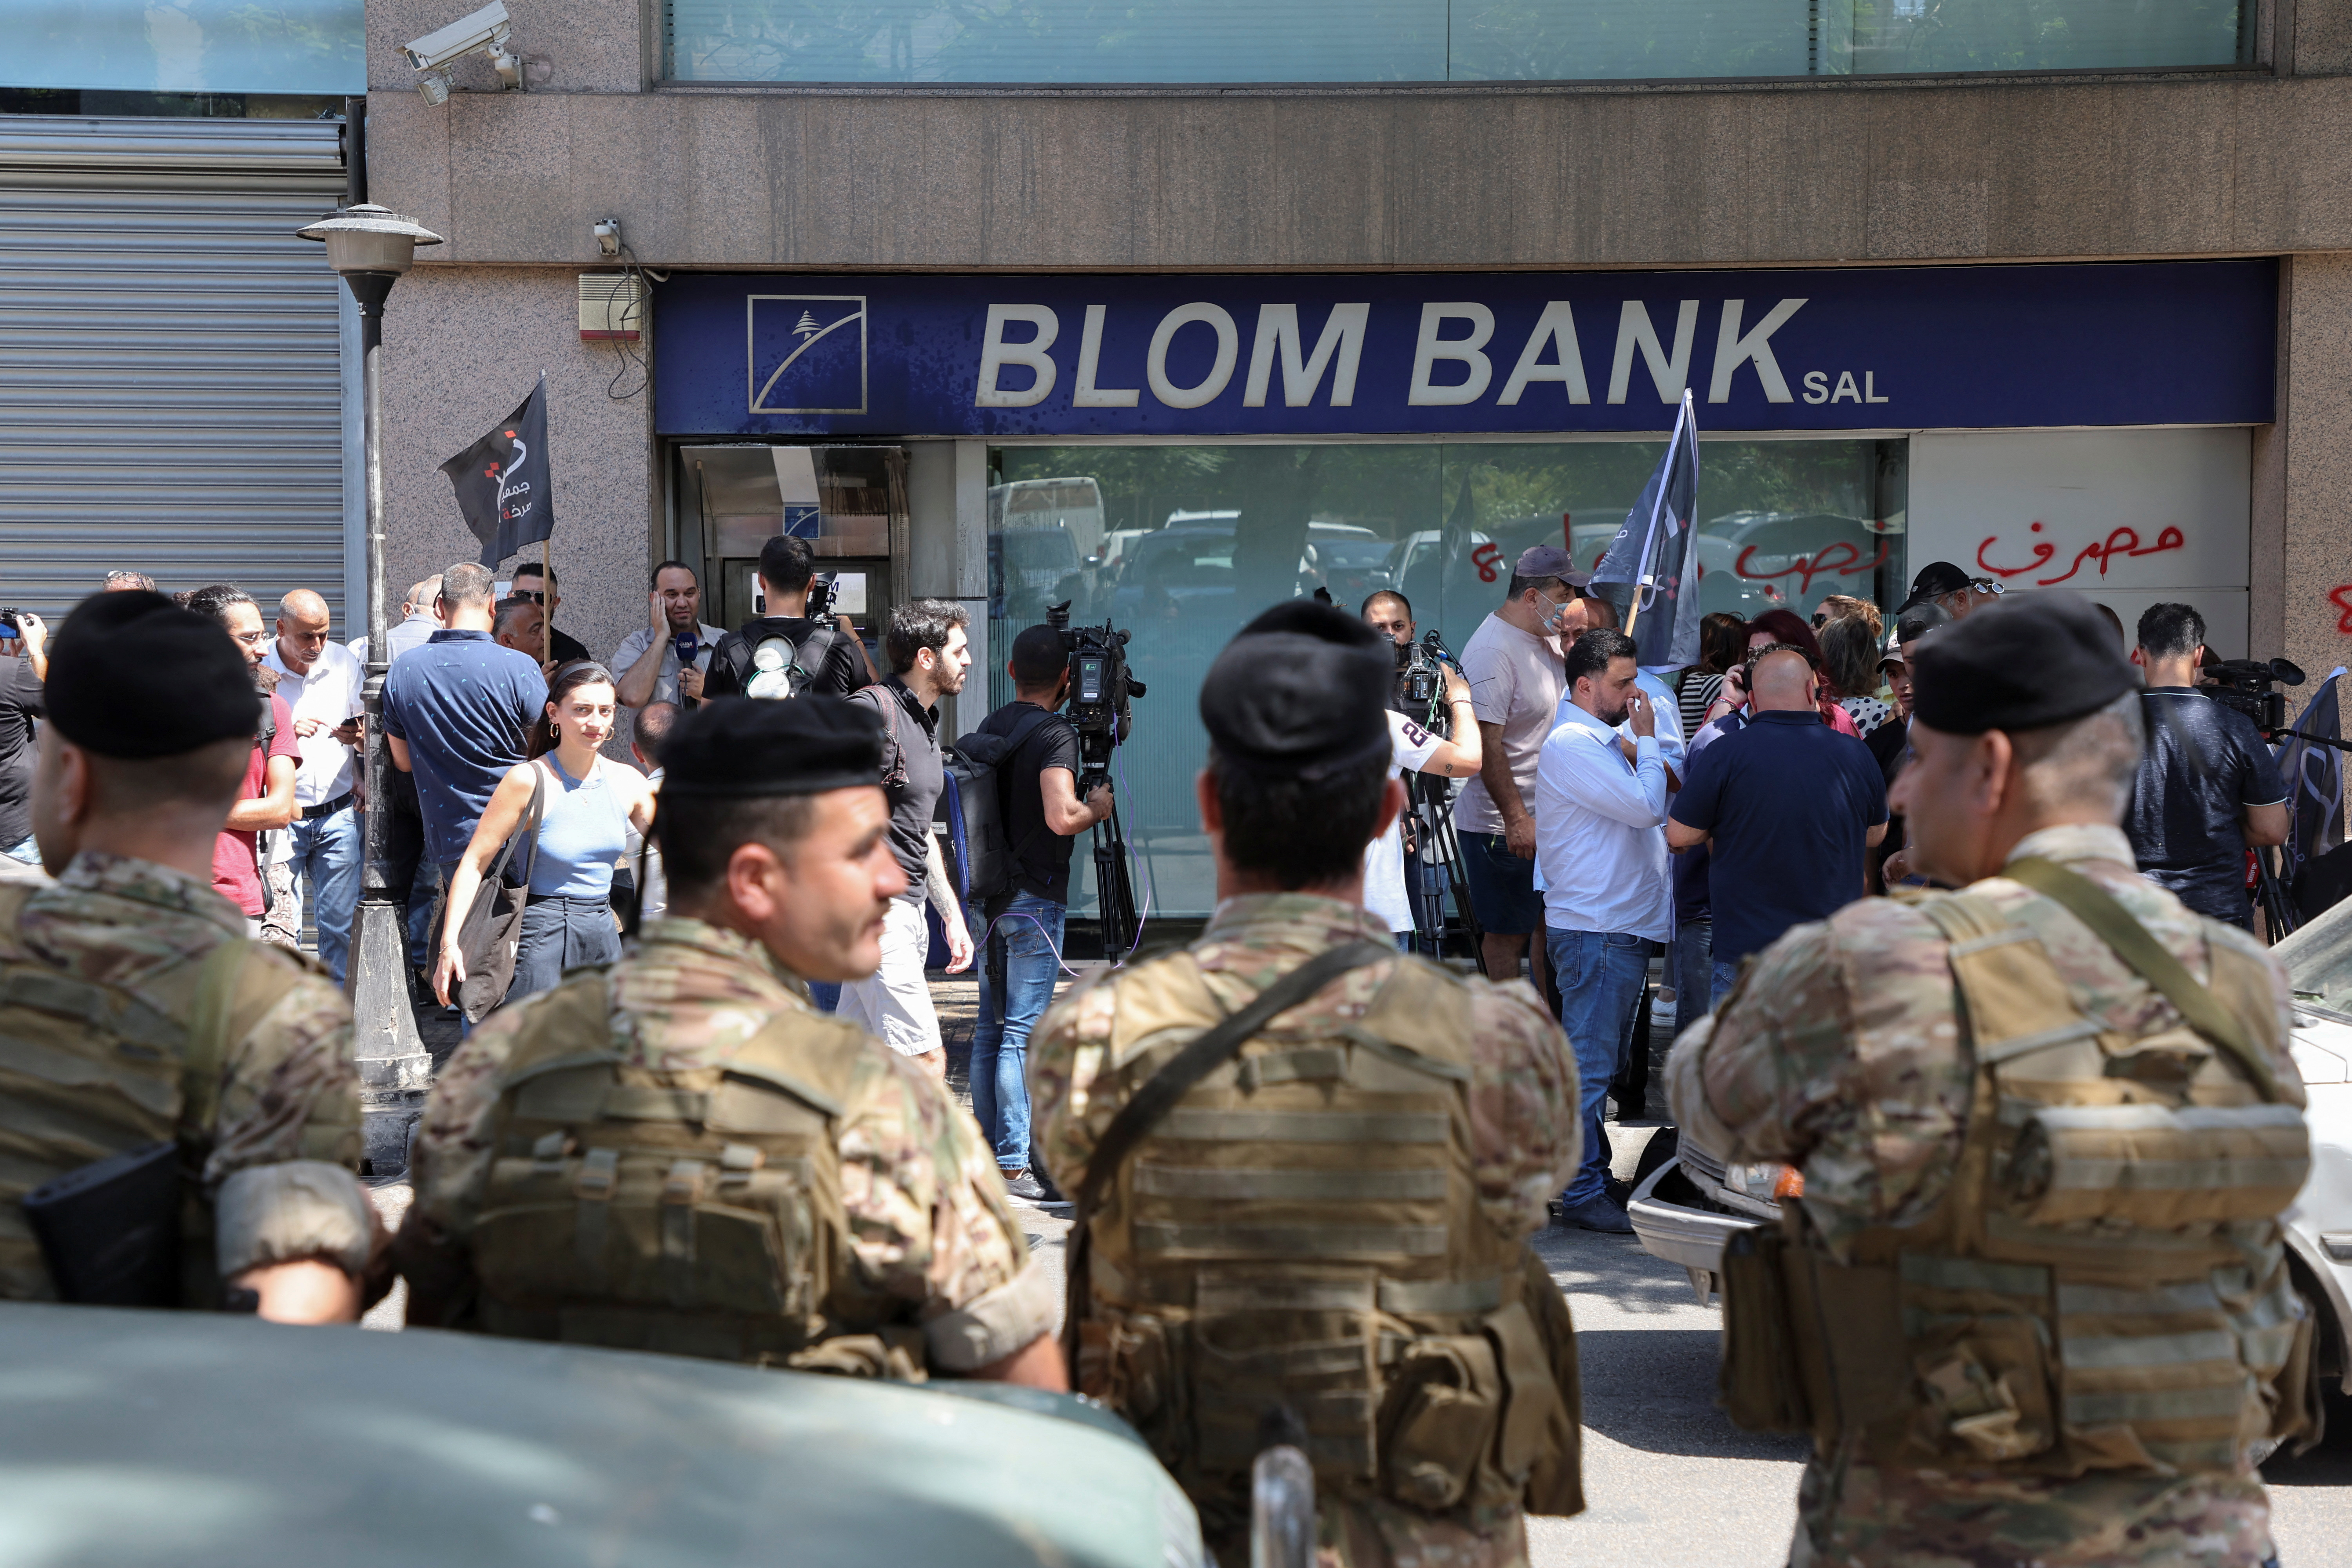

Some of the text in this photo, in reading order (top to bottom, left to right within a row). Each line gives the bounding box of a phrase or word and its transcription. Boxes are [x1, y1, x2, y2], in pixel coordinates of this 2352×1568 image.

[975, 299, 1889, 408] BLOM BANK SAL
[501, 482, 530, 503] جمعي
[502, 502, 532, 519] صرخة
[1976, 522, 2184, 586] مصرف
